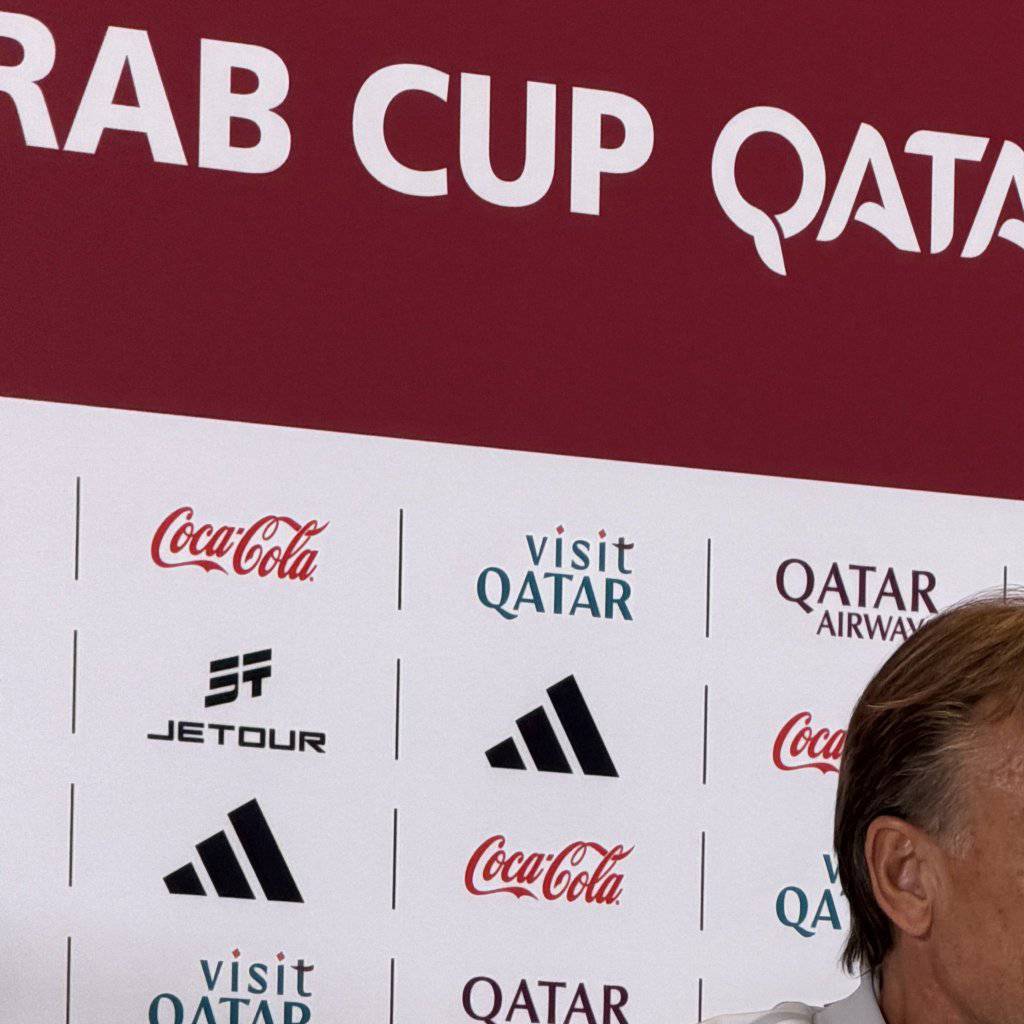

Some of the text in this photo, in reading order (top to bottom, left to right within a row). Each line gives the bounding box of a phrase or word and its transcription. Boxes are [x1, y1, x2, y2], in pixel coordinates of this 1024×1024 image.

[352, 64, 654, 215] CUP
[151, 507, 329, 581] Coca-Cola
[525, 525, 634, 575] visit
[477, 566, 633, 620] QATAR
[776, 559, 938, 613] QATAR
[816, 610, 925, 641] AIRWAY
[147, 720, 325, 753] JETOUR
[465, 835, 634, 905] Coca-Cola
[200, 949, 314, 997] visit
